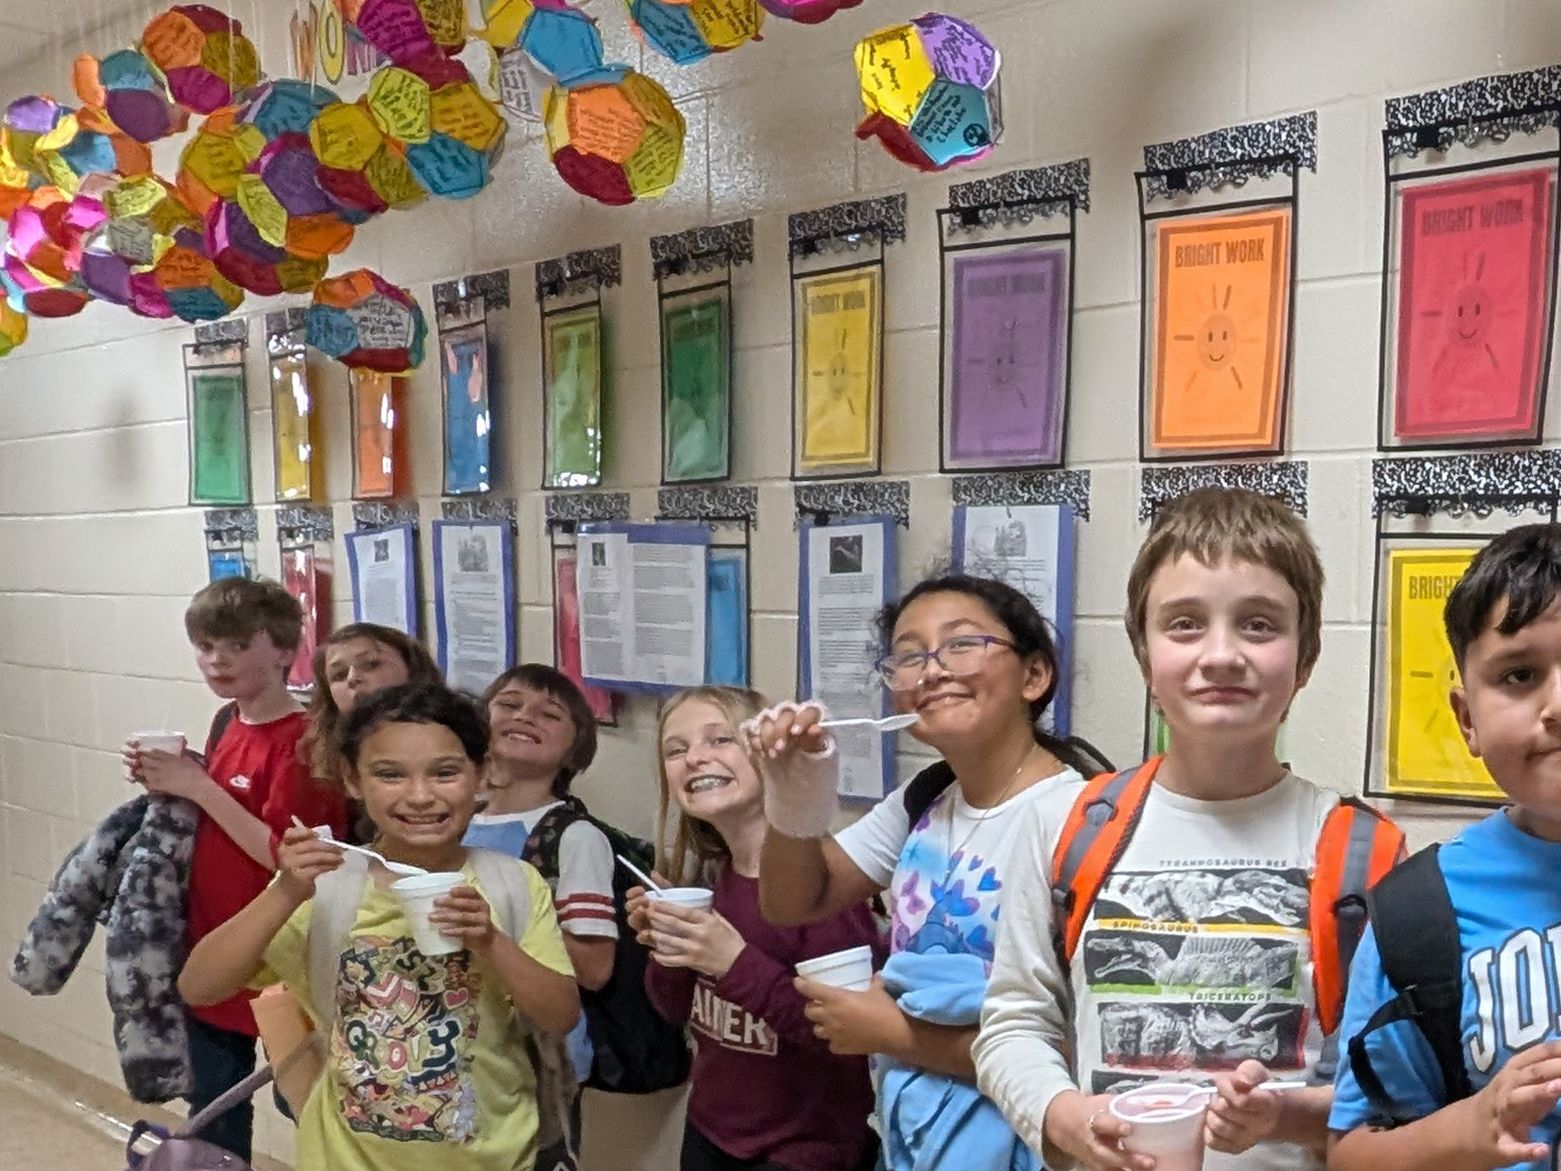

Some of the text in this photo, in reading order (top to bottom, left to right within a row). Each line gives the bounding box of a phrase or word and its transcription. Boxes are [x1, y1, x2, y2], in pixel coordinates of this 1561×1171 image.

[1175, 237, 1265, 268] BRIGHT WORK
[1113, 922, 1199, 934] SPINOSAURUS
[1189, 991, 1272, 1002] TRICERATOPS
